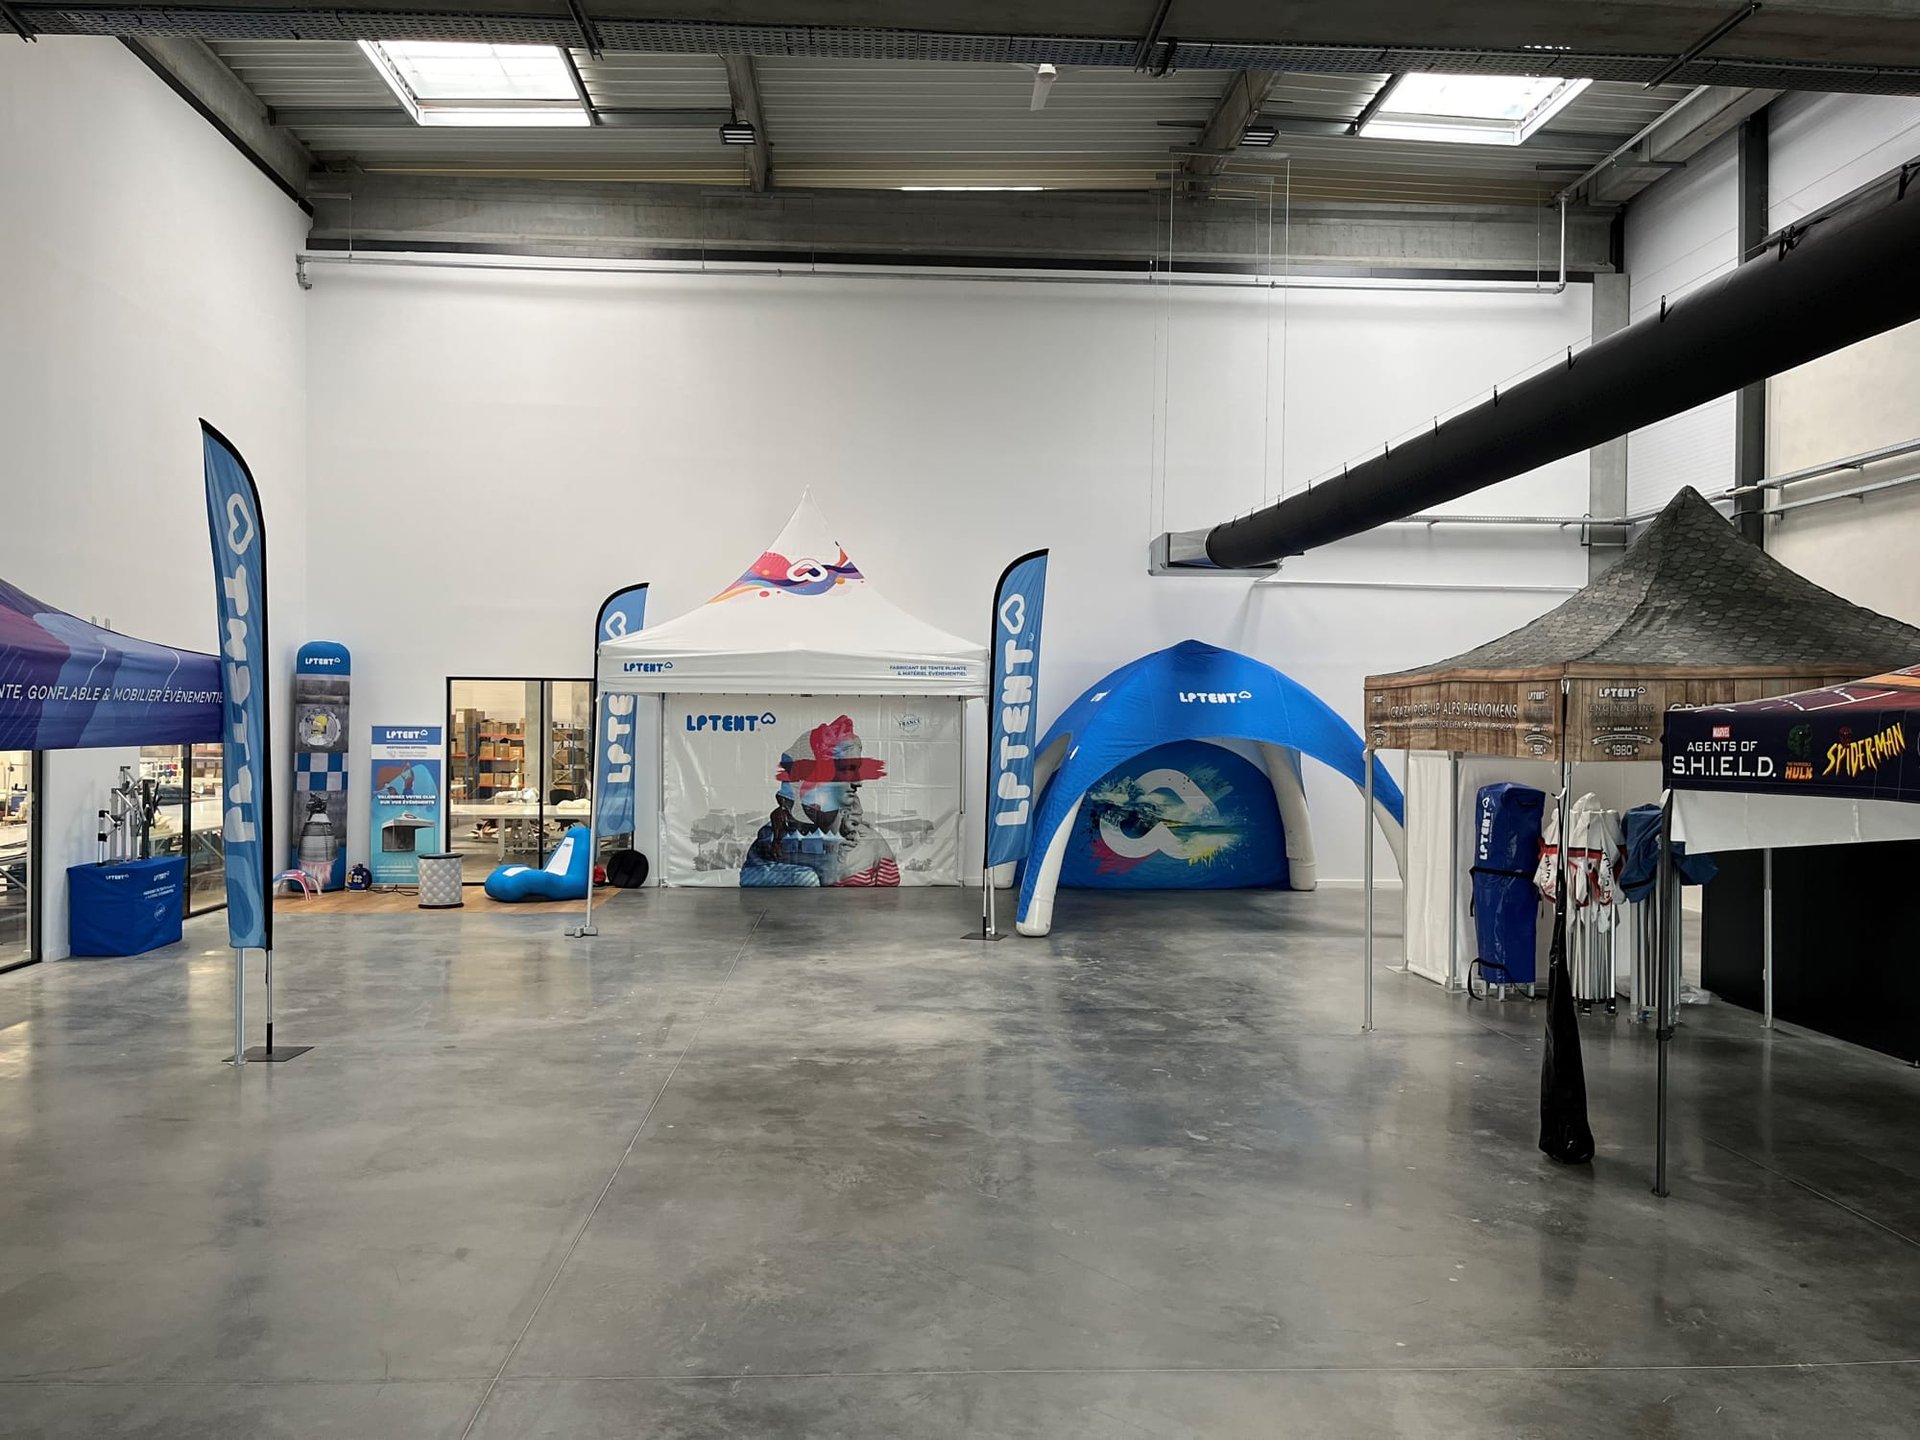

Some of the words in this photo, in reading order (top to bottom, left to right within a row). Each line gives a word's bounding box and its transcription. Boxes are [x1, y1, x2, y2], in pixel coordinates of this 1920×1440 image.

[305, 657, 334, 665] LPTENT
[624, 663, 663, 672] LPTENT
[27, 685, 101, 700] GONFLABLE
[102, 687, 111, 701] &
[113, 687, 163, 702] MOBILIER
[1179, 691, 1238, 704] LPTENT
[1599, 688, 1637, 698] LPTENT
[1413, 702, 1440, 717] POP-UP
[1443, 701, 1461, 715] ALPS
[1463, 702, 1518, 719] PHENOMENS
[686, 714, 759, 732] LPTENT
[386, 730, 420, 739] LPTENT
[995, 639, 1034, 827] LPTENT
[1687, 741, 1737, 752] AGENTS
[1740, 741, 1758, 752] OF
[1822, 722, 1906, 777] SPIDER-MAN
[1672, 755, 1777, 778] S.H.I.E.L.D.
[1785, 766, 1813, 780] HULK
[1479, 808, 1491, 860] LPTENT
